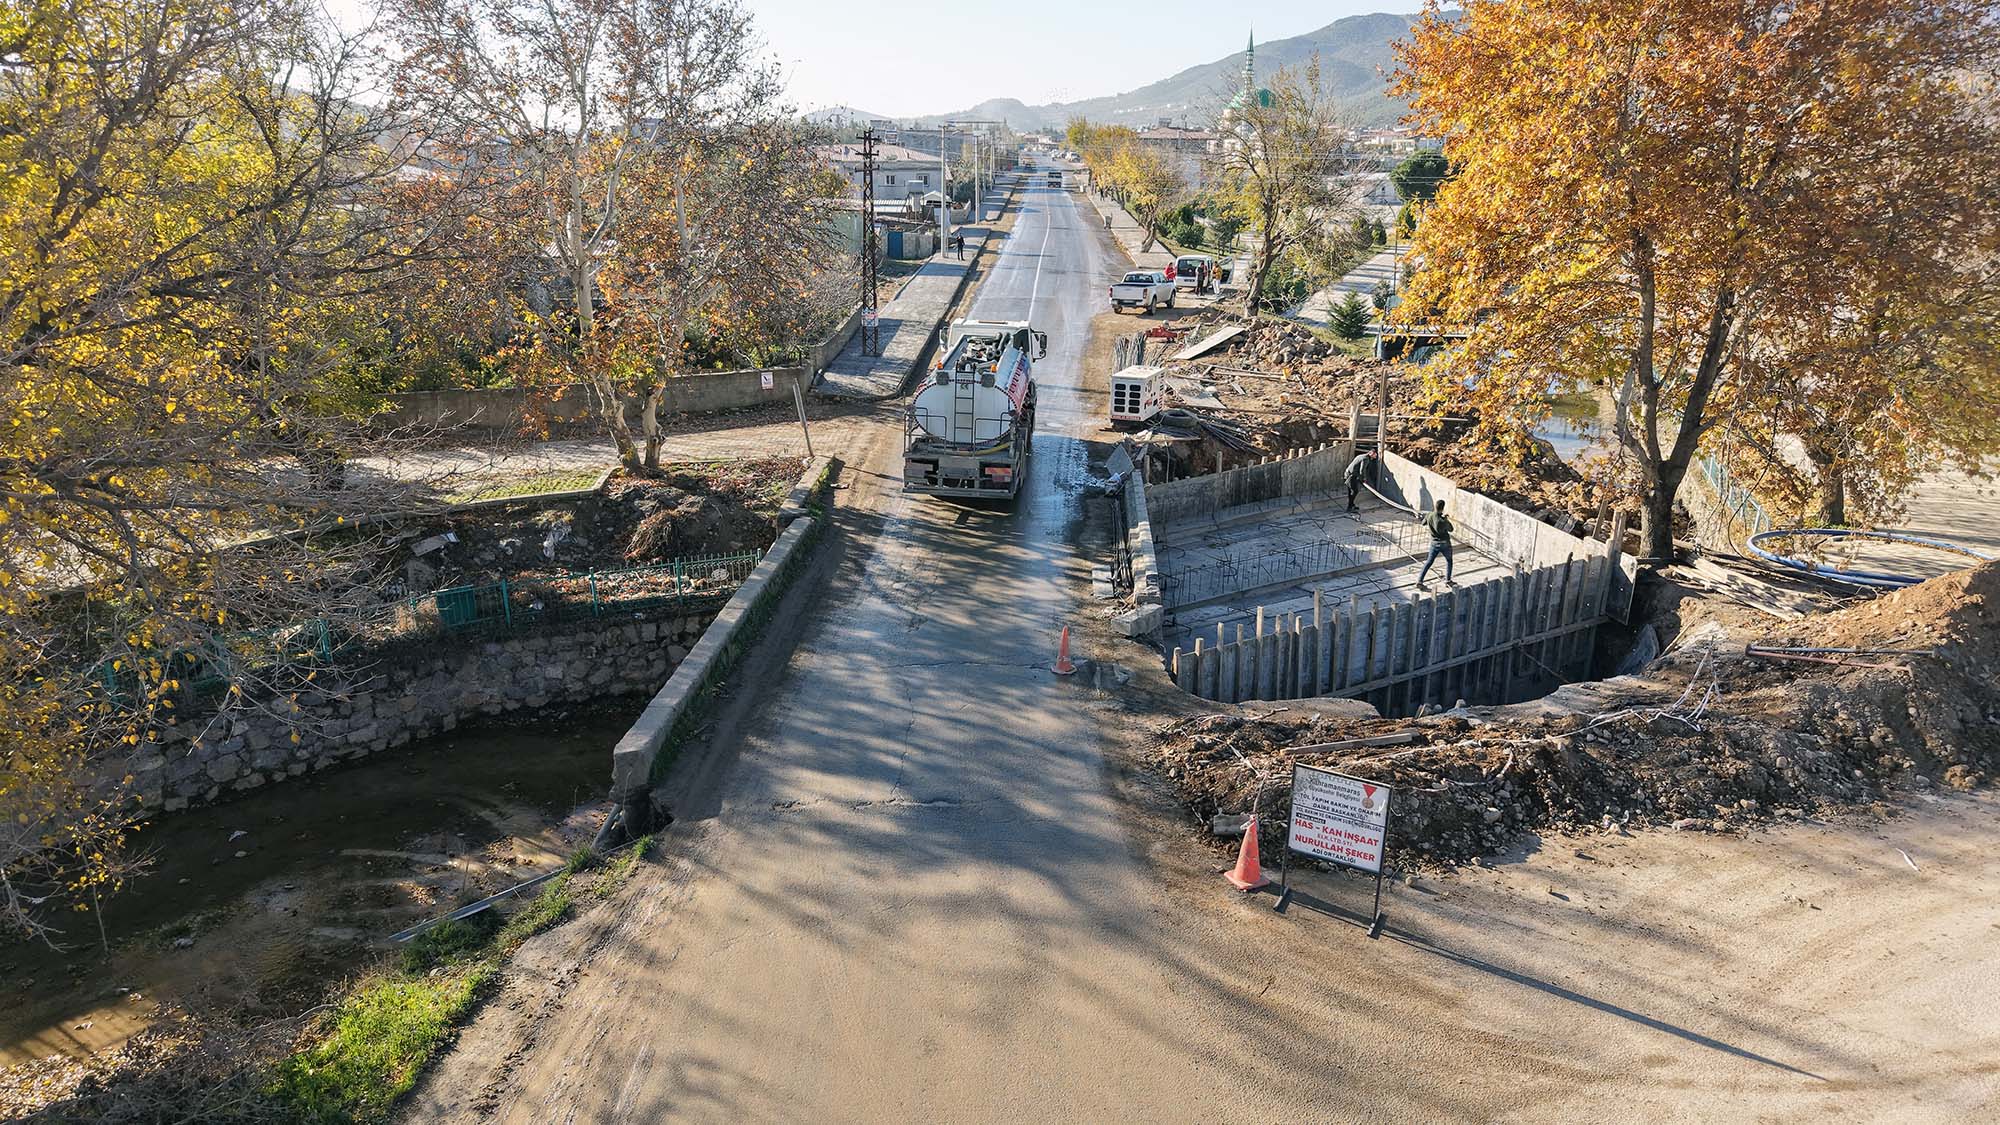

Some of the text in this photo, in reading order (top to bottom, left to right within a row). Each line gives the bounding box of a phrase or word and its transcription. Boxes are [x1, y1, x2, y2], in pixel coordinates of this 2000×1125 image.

[1295, 819, 1313, 829] HAS
[1322, 826, 1342, 836] KAN
[1344, 830, 1379, 846] İNŞAAT
[1295, 834, 1375, 861] NURULLAH ŞEKER
